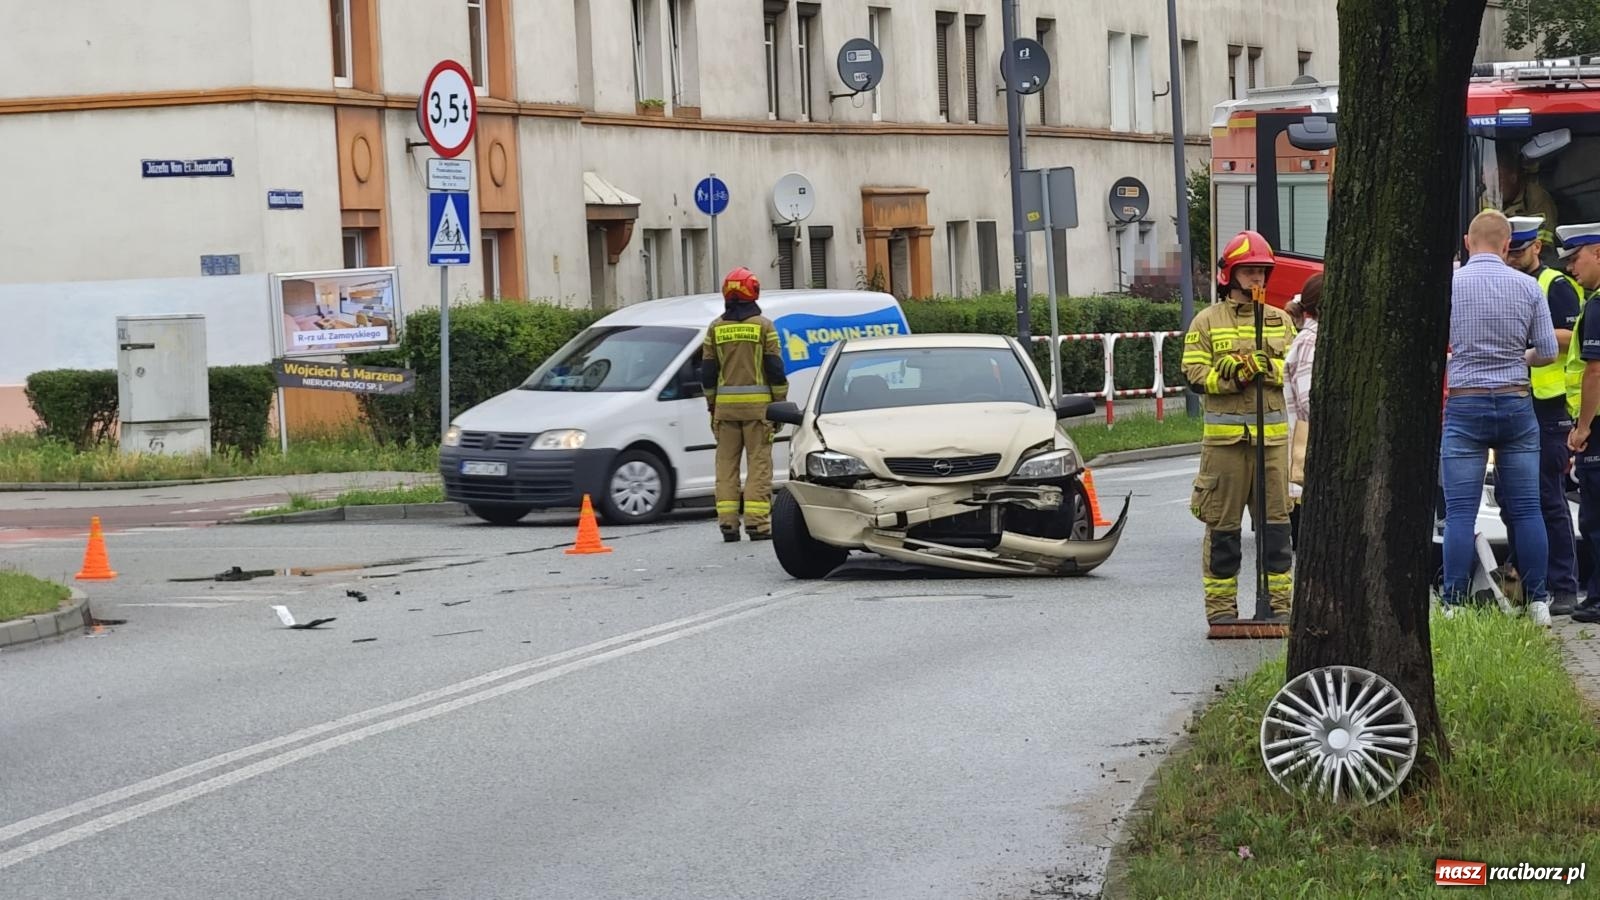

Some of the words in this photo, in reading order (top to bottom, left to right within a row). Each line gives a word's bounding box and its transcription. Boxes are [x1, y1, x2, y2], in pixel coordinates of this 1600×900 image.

[328, 330, 381, 341] Zamoyskiego
[806, 323, 899, 344] KOMIN-FREZ
[1215, 341, 1230, 350] PSP
[284, 363, 338, 379] Wojciech
[340, 367, 350, 379] &
[353, 368, 404, 383] Marzena
[302, 378, 365, 390] NIERUCHOMOŚCI
